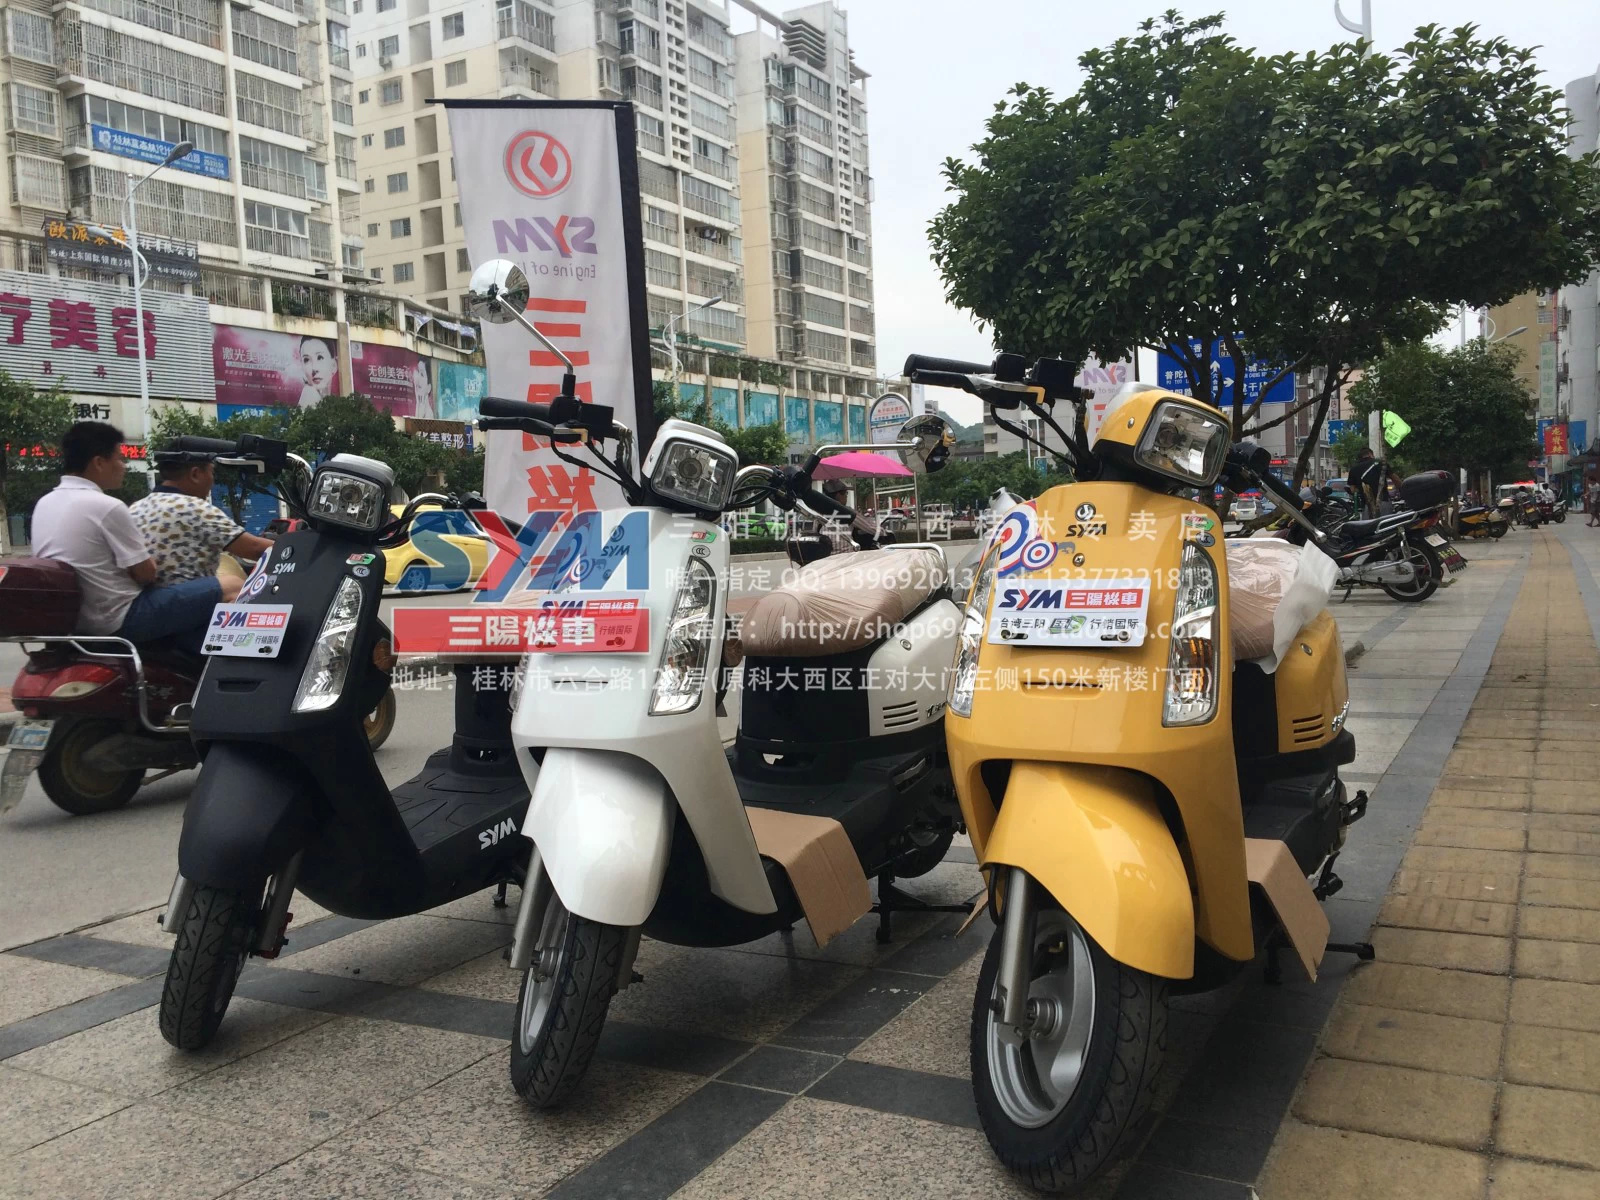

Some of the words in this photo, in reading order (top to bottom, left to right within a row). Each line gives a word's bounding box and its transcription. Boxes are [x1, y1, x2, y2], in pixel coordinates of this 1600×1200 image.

[1065, 523, 1107, 538] SYM
[272, 562, 296, 575] SYM
[998, 588, 1063, 611] SYM
[1069, 591, 1138, 606] 三陽機車
[538, 600, 584, 618] SYM
[212, 610, 248, 628] SYM
[478, 817, 517, 851] SYM
